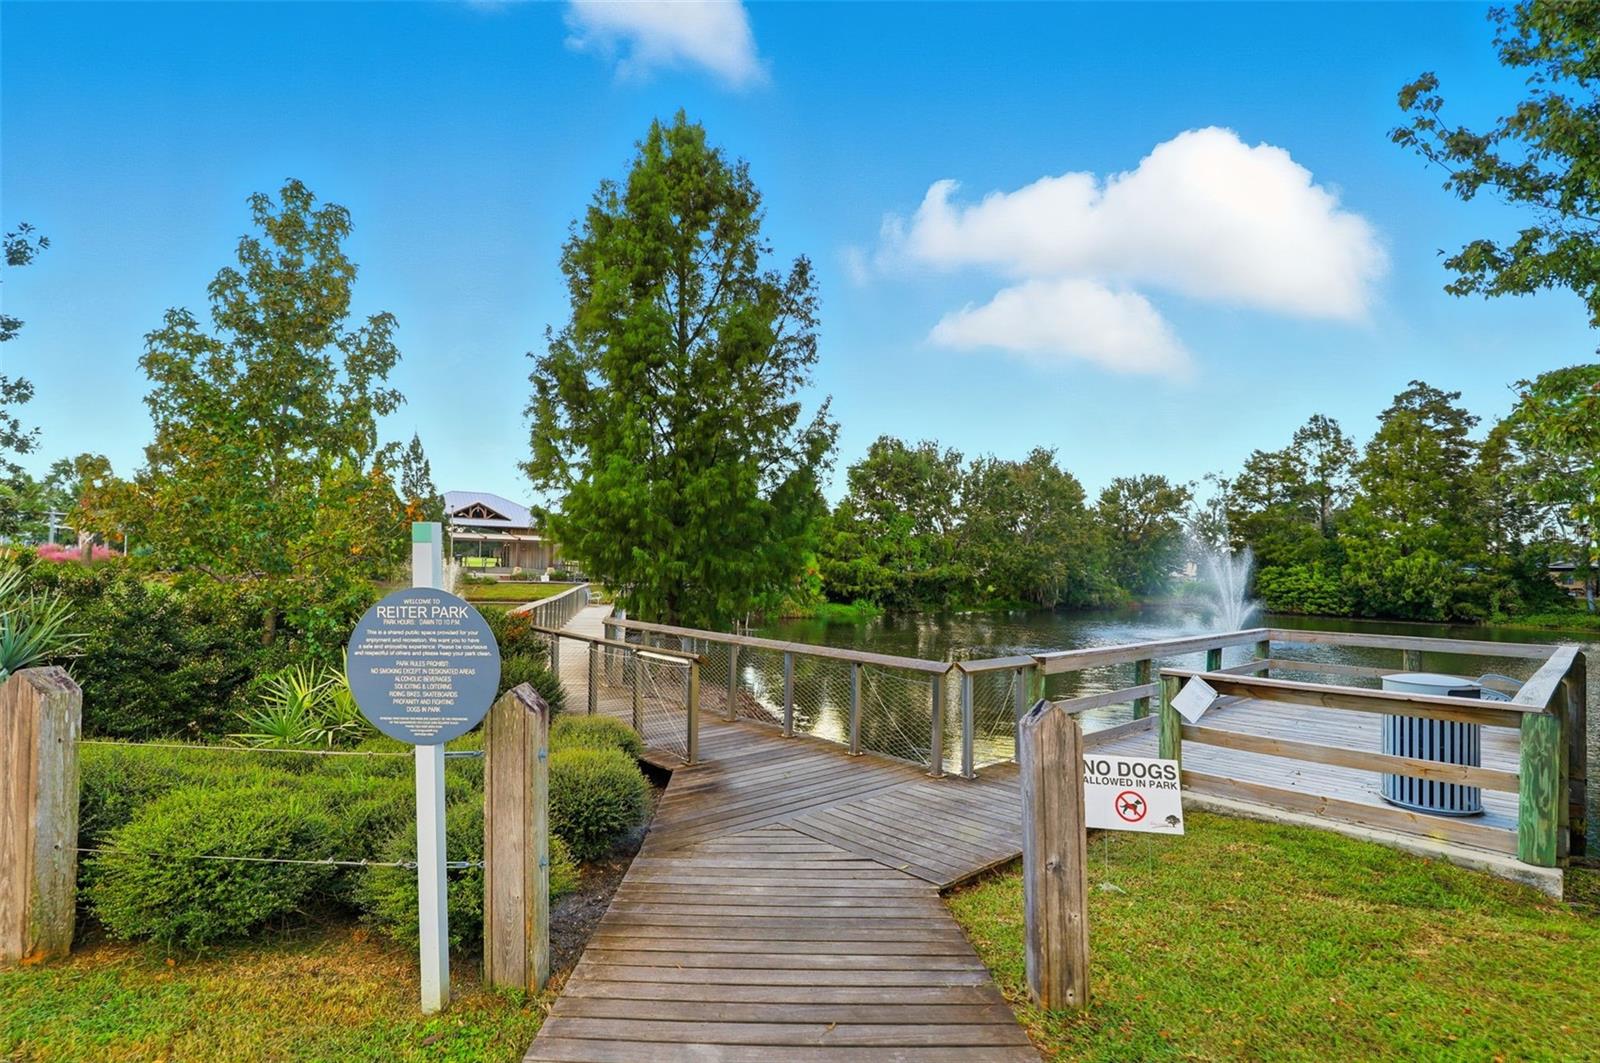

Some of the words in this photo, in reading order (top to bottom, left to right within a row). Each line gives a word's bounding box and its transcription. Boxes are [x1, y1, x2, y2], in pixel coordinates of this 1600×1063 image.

[377, 606, 428, 618] REITER
[432, 606, 468, 618] PARK
[1083, 760, 1111, 776] NO
[1118, 762, 1177, 781] DOGS
[1084, 776, 1133, 787] ALLOWED
[1136, 779, 1146, 788] IN
[1149, 780, 1178, 790] PARK
